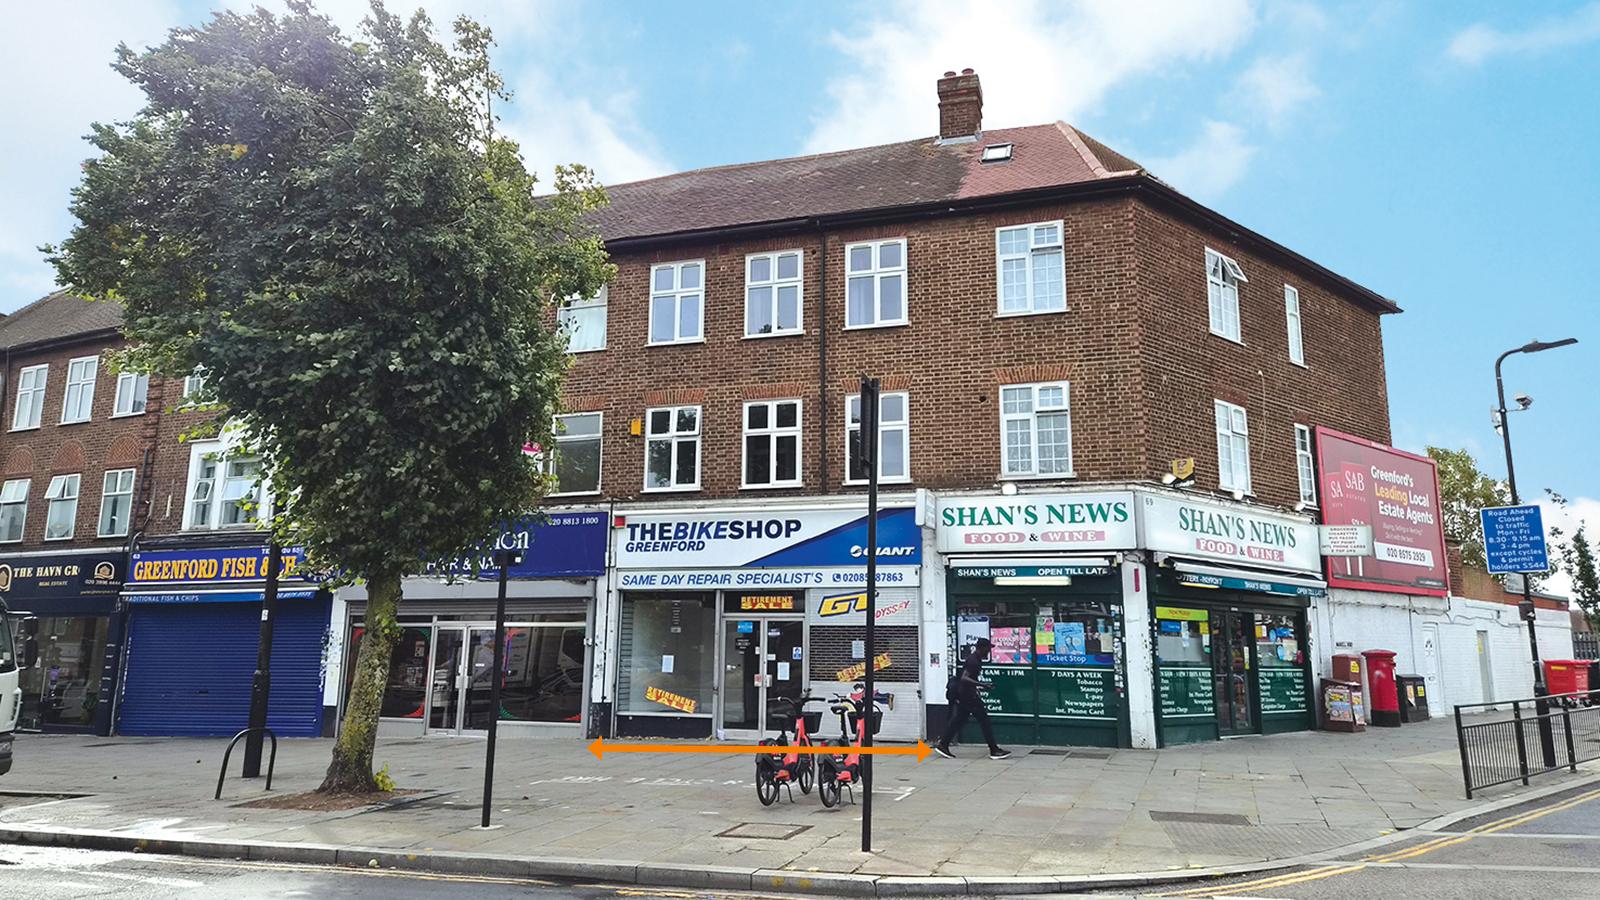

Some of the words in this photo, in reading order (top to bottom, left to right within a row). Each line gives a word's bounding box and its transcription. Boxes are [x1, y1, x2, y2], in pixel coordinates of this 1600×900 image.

[1345, 470, 1364, 491] SAB
[1370, 465, 1414, 488] Greenford's
[1374, 483, 1408, 506] Leading
[1408, 490, 1430, 507] Local
[942, 505, 1038, 526] SHAN'S
[1046, 502, 1128, 524] NEWS
[1378, 500, 1404, 519] Estate
[1406, 506, 1434, 525] Agents
[548, 518, 561, 526] 20
[582, 516, 598, 524] 1800
[1179, 506, 1246, 540] SHAN'S
[1250, 520, 1296, 548] NEWS
[970, 533, 1020, 543] FOOD
[1029, 533, 1039, 542] &
[1047, 530, 1096, 541] WINE
[625, 540, 706, 552] GREENFORD
[1200, 539, 1234, 554] FOOD
[1240, 548, 1246, 556] &
[1250, 548, 1281, 561] WINE
[1386, 547, 1398, 558] 020
[134, 558, 218, 580] GREENFORD
[220, 557, 257, 578] FISH
[462, 558, 472, 570] &
[13, 568, 33, 578] THE
[36, 566, 62, 577] HAVN
[64, 566, 80, 576] GR
[842, 572, 903, 582] 0208587863
[958, 568, 990, 577] SHAN'S
[990, 568, 1016, 576] NEWS
[1038, 568, 1064, 576] OPEN
[622, 574, 657, 586] SAME
[661, 574, 685, 586] DAY
[687, 574, 732, 584] REPAIR
[736, 572, 824, 584] SPECIALIST'S
[741, 602, 793, 610] SALE
[874, 600, 910, 618] DYSSEY
[1046, 654, 1068, 662] Ticket
[1068, 655, 1086, 664] Stop
[646, 686, 696, 706] RETIREMENT
[1064, 700, 1104, 708] Newspapers
